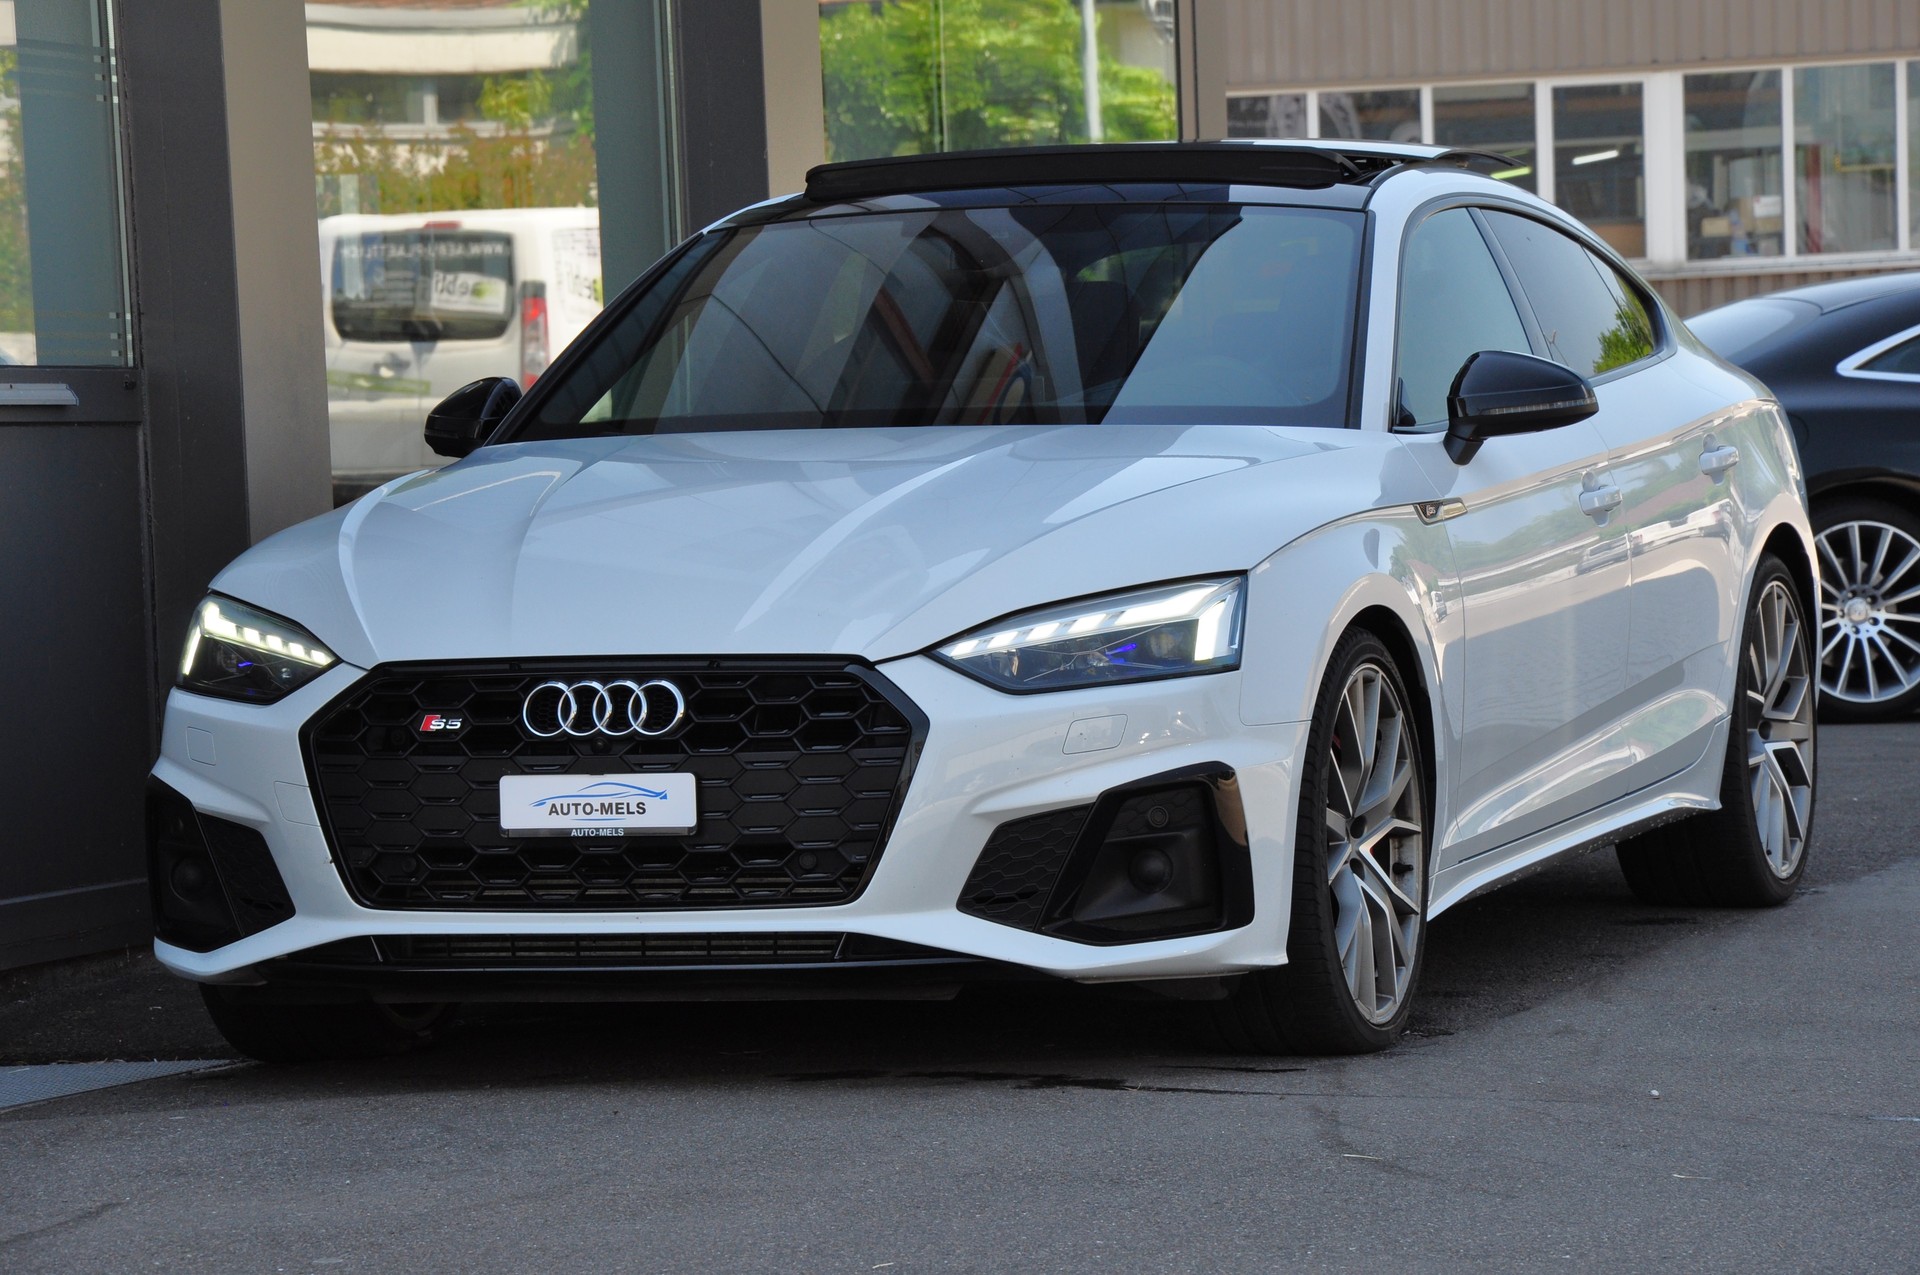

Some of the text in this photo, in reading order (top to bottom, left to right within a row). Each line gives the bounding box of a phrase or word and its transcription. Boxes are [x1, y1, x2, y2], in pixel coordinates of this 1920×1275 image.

[427, 717, 462, 730] S5
[548, 802, 647, 816] AUTO-MELS
[570, 828, 624, 837] AUTO-MELS
